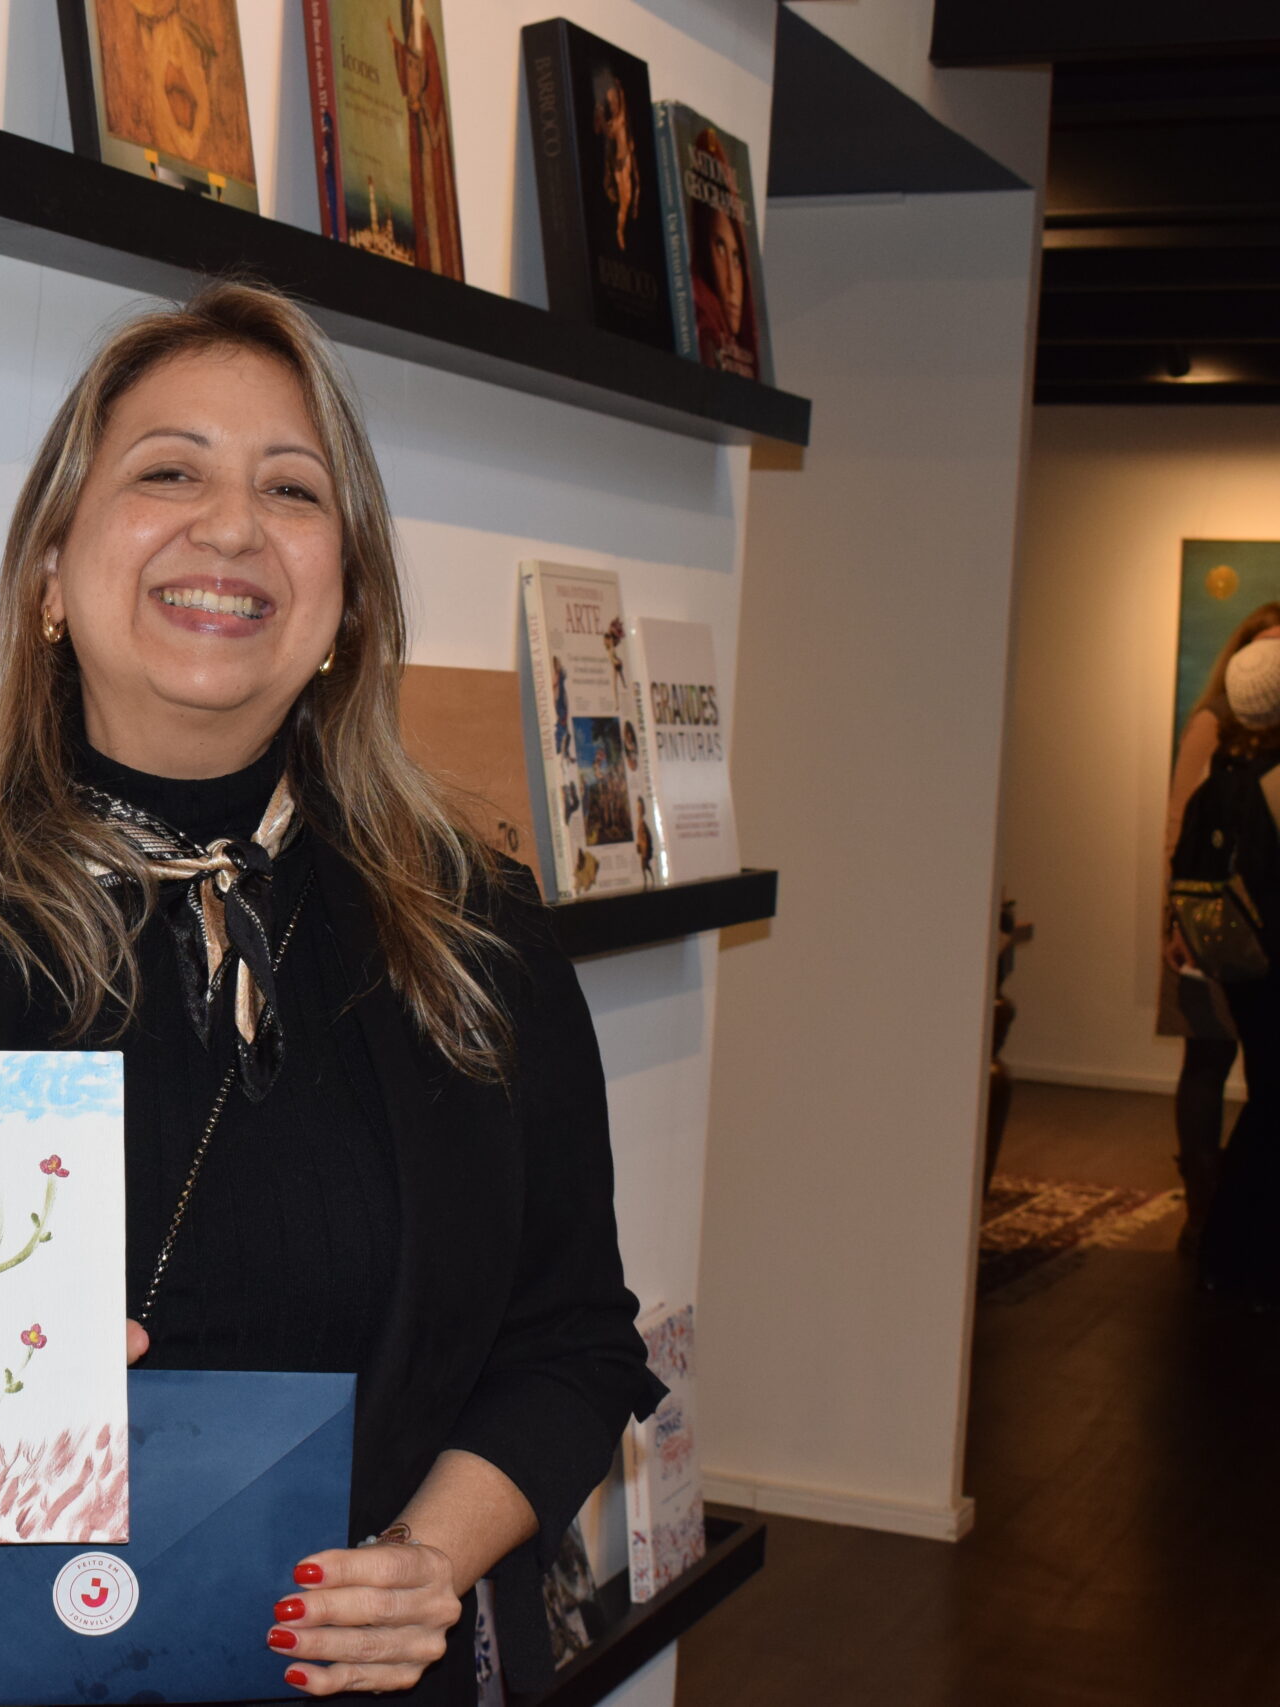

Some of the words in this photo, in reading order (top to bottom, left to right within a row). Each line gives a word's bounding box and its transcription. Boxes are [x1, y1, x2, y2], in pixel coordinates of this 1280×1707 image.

[534, 56, 563, 158] BARROCO
[566, 602, 606, 636] ARTE
[650, 681, 719, 726] GRANDES
[656, 731, 724, 762] PINTURAS
[77, 1560, 104, 1570] FEITO
[108, 1564, 119, 1574] EM
[69, 1612, 114, 1626] JOINVILLE
